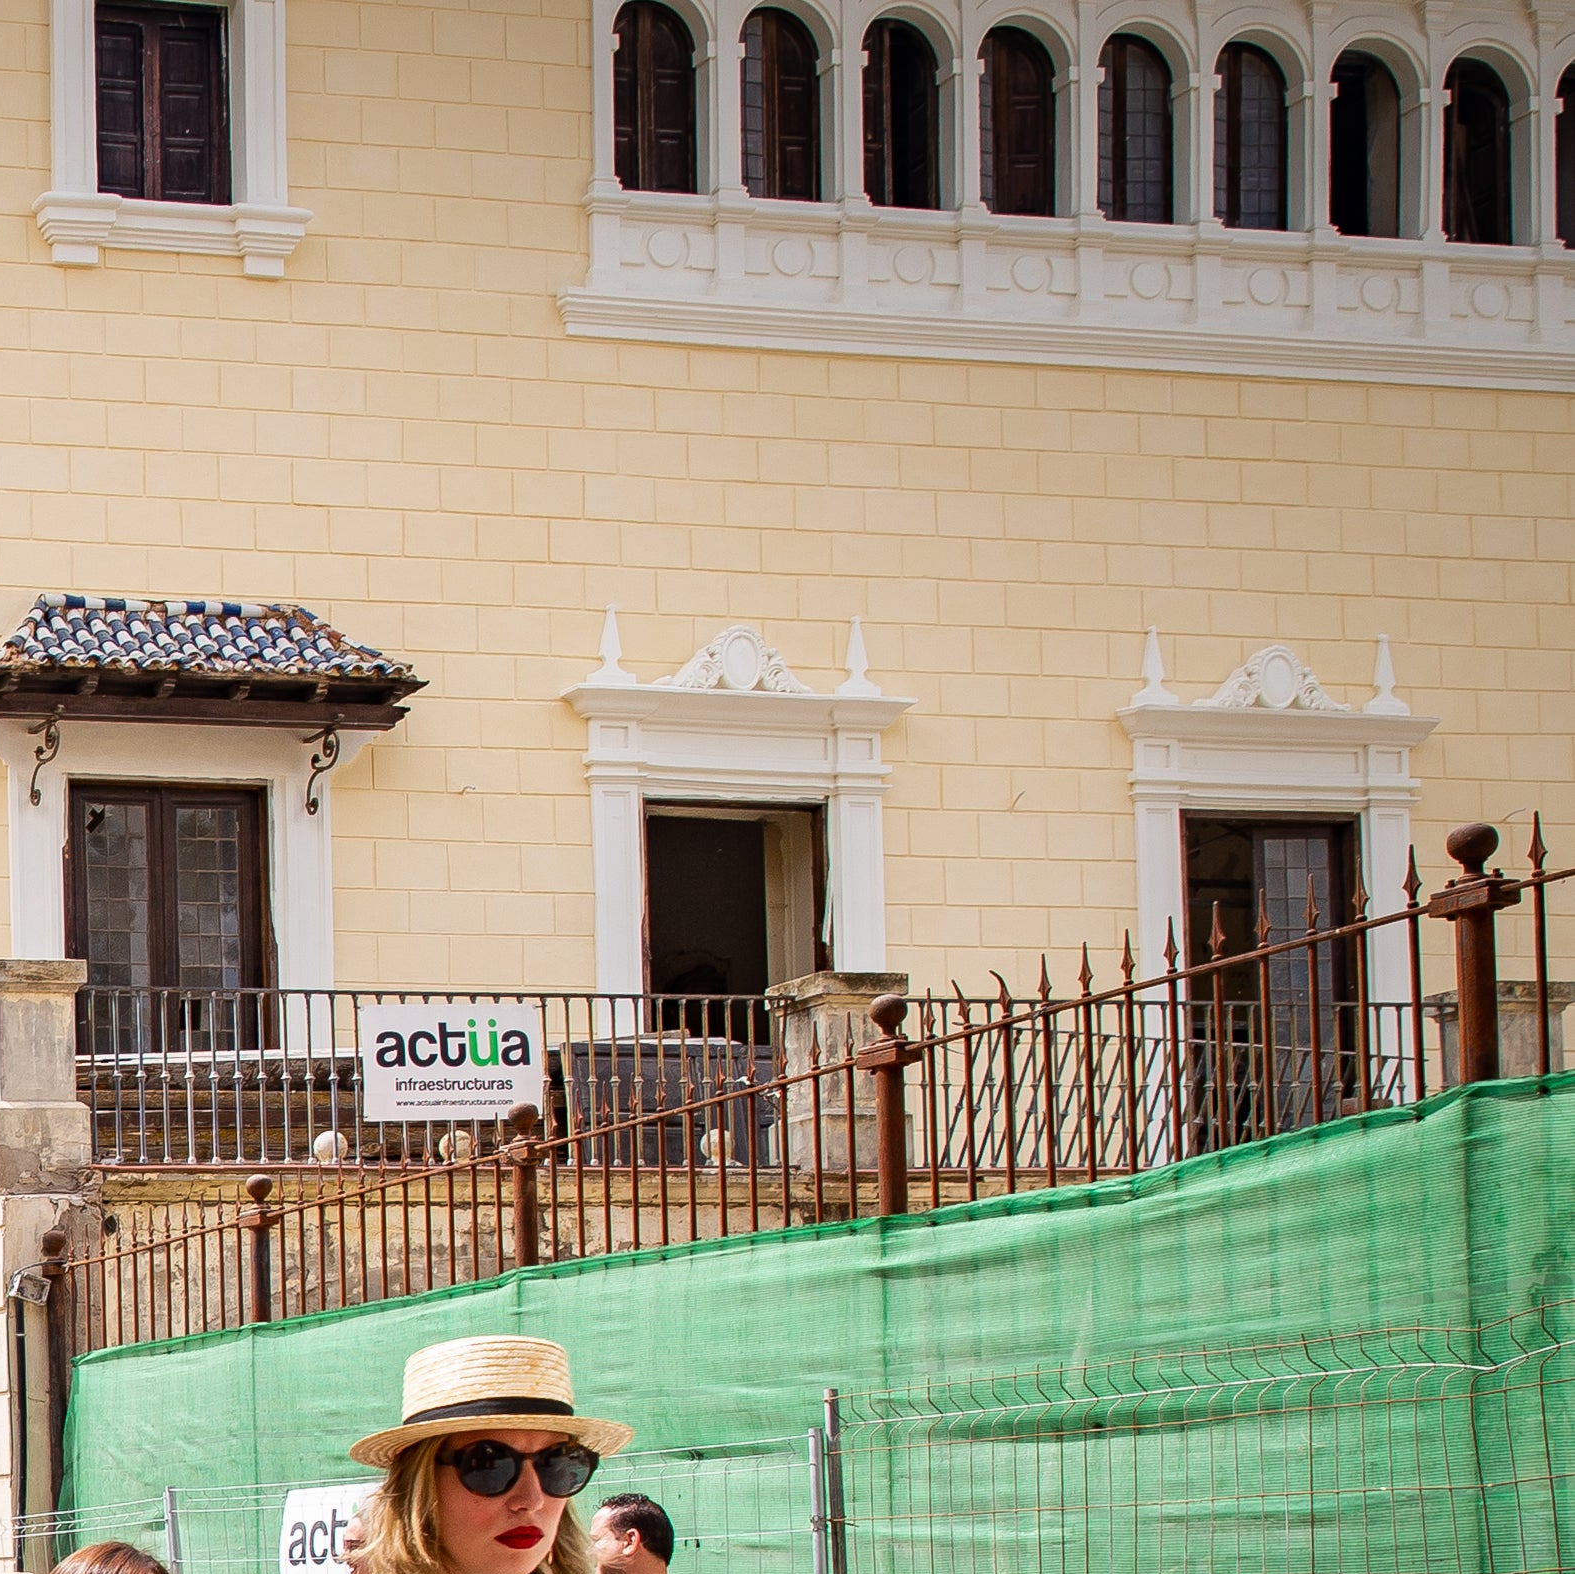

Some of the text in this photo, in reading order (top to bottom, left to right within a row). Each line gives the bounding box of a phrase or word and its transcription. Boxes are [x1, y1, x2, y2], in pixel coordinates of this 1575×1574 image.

[375, 1018, 531, 1068] actüa
[395, 1077, 513, 1092] infraestructuras
[289, 1502, 358, 1566] act
